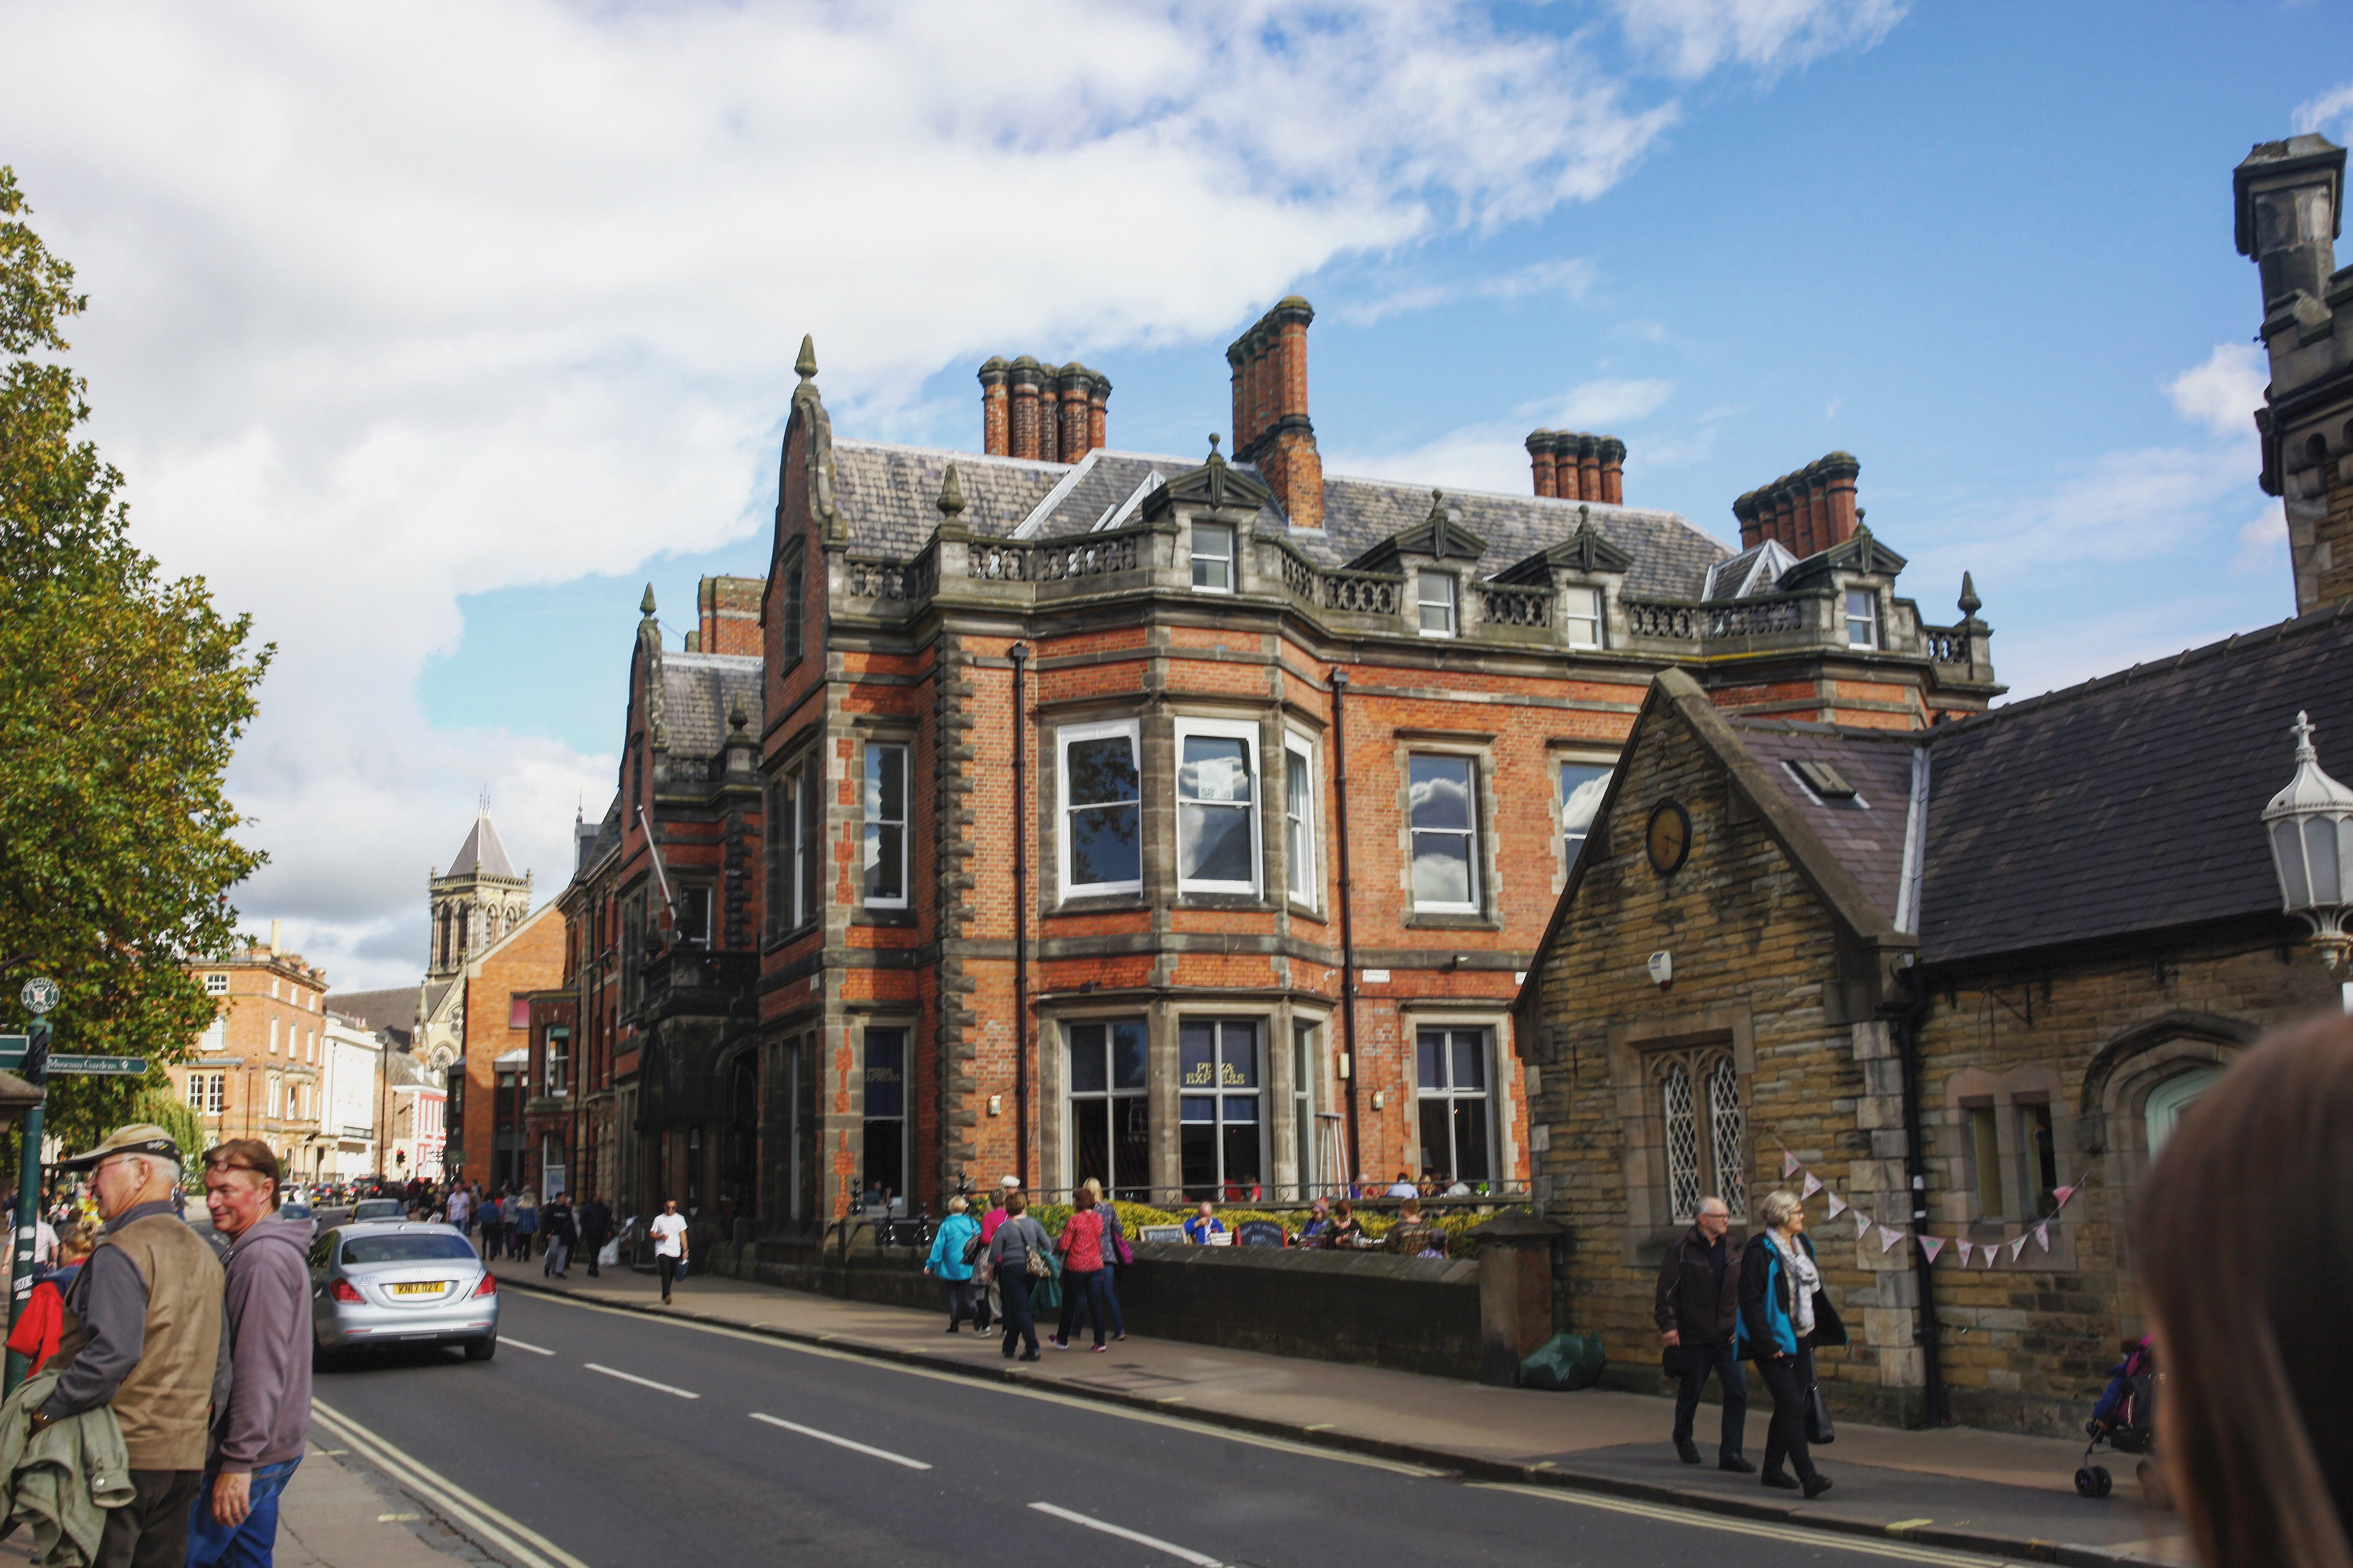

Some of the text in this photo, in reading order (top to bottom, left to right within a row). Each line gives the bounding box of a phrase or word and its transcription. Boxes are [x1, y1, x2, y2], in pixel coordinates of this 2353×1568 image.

[49, 1059, 117, 1070] Museum Gardens
[1186, 1073, 1245, 1084] EXPESS
